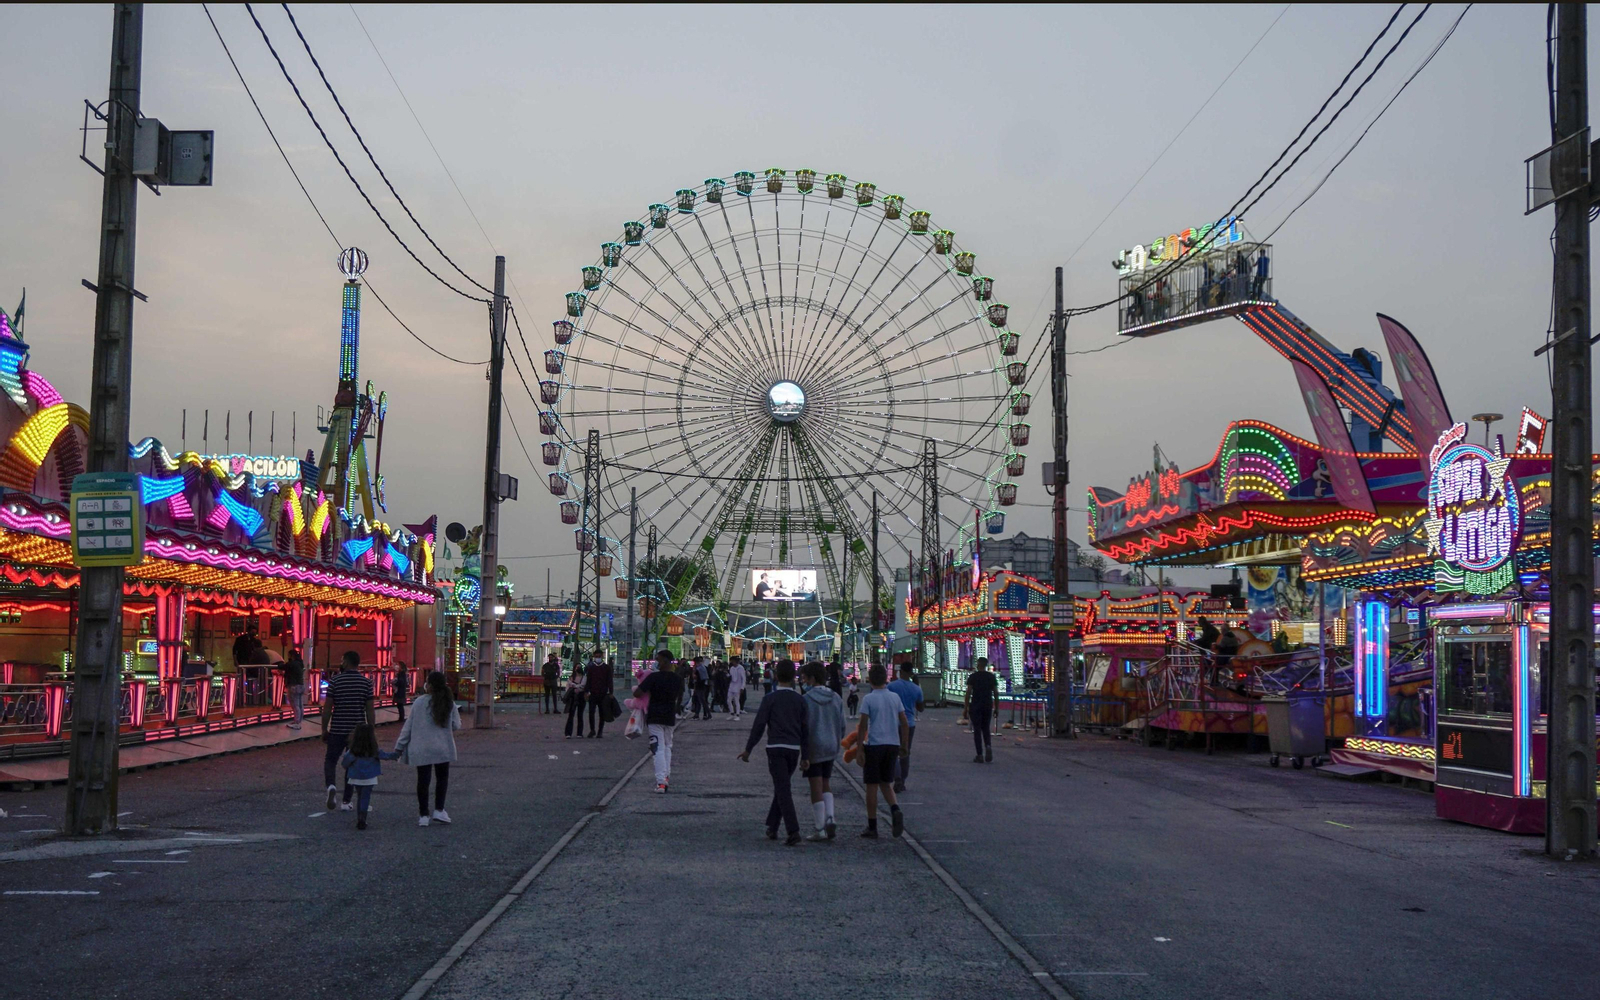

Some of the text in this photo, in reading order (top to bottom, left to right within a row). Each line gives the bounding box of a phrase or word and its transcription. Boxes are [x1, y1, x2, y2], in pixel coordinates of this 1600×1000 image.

[1119, 244, 1147, 276] LA
[231, 454, 297, 476] VACILÓN
[1437, 459, 1482, 507] SUPER
[1203, 600, 1224, 609] SALIDA
